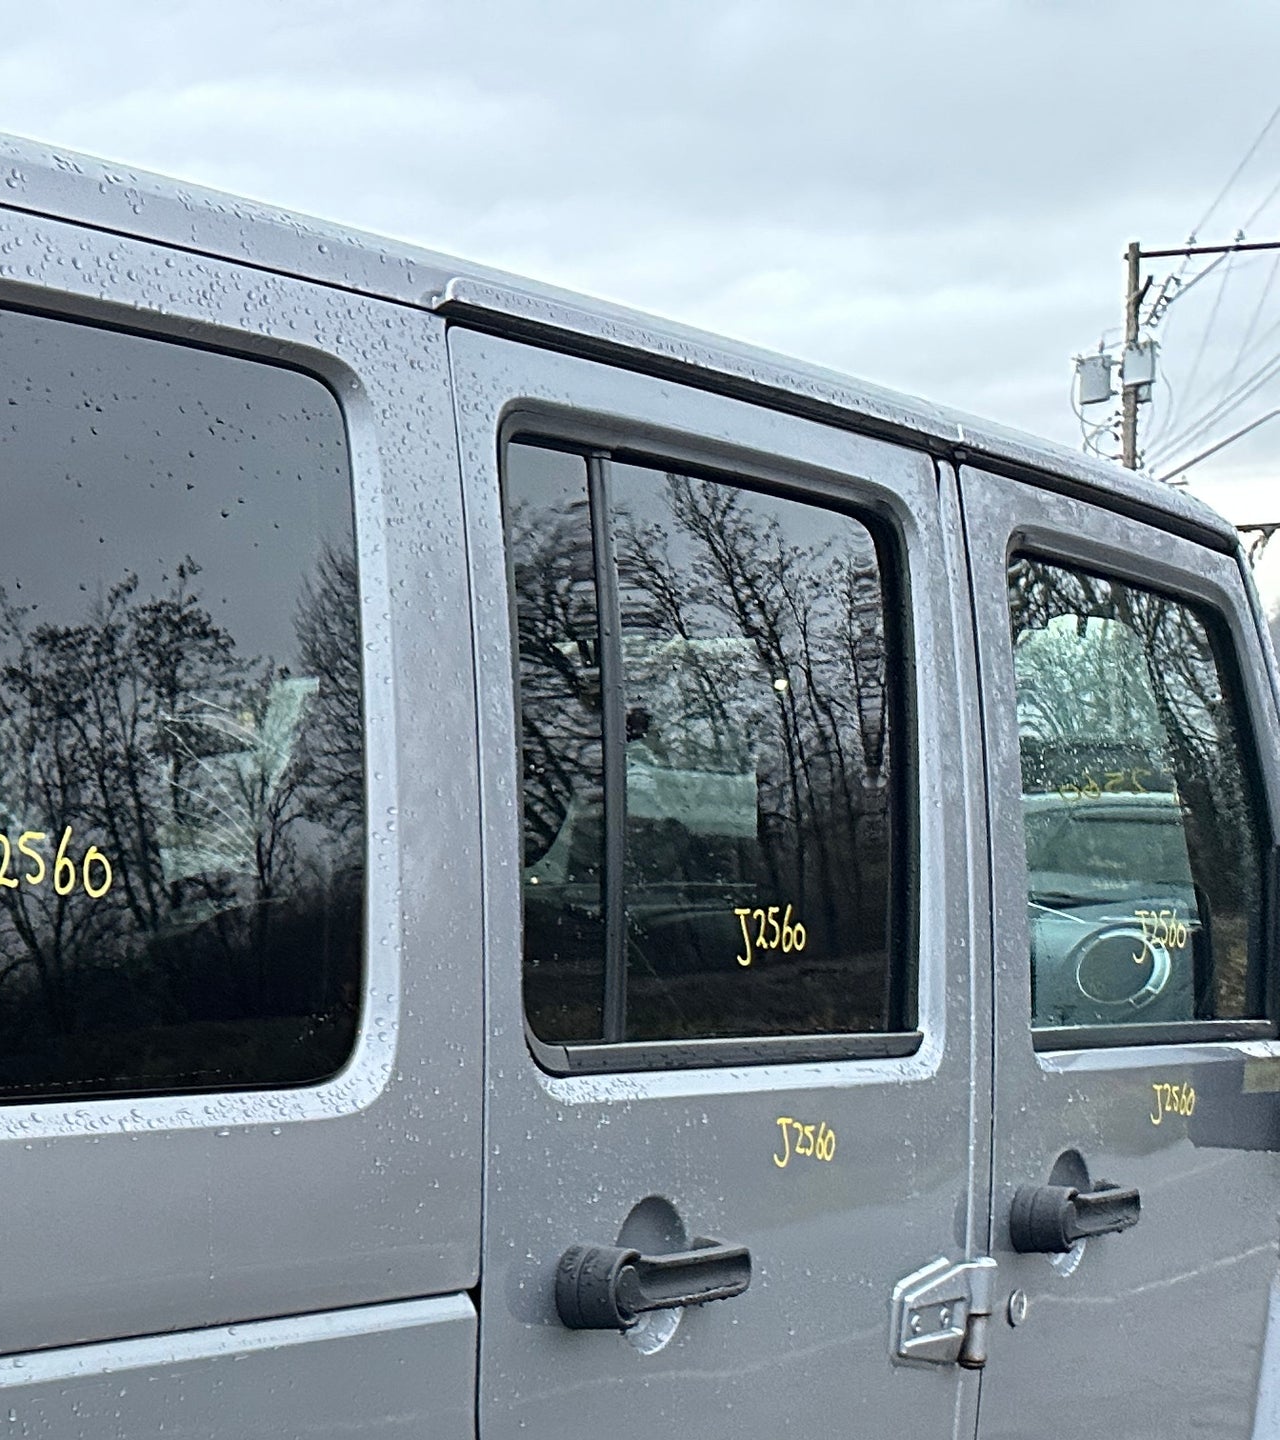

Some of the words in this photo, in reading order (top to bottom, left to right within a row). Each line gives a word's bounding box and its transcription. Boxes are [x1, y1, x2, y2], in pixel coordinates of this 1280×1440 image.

[734, 904, 806, 966] J2560
[1132, 909, 1187, 963] J2560
[1150, 1082, 1196, 1125] J2560
[774, 1117, 835, 1168] J2560
